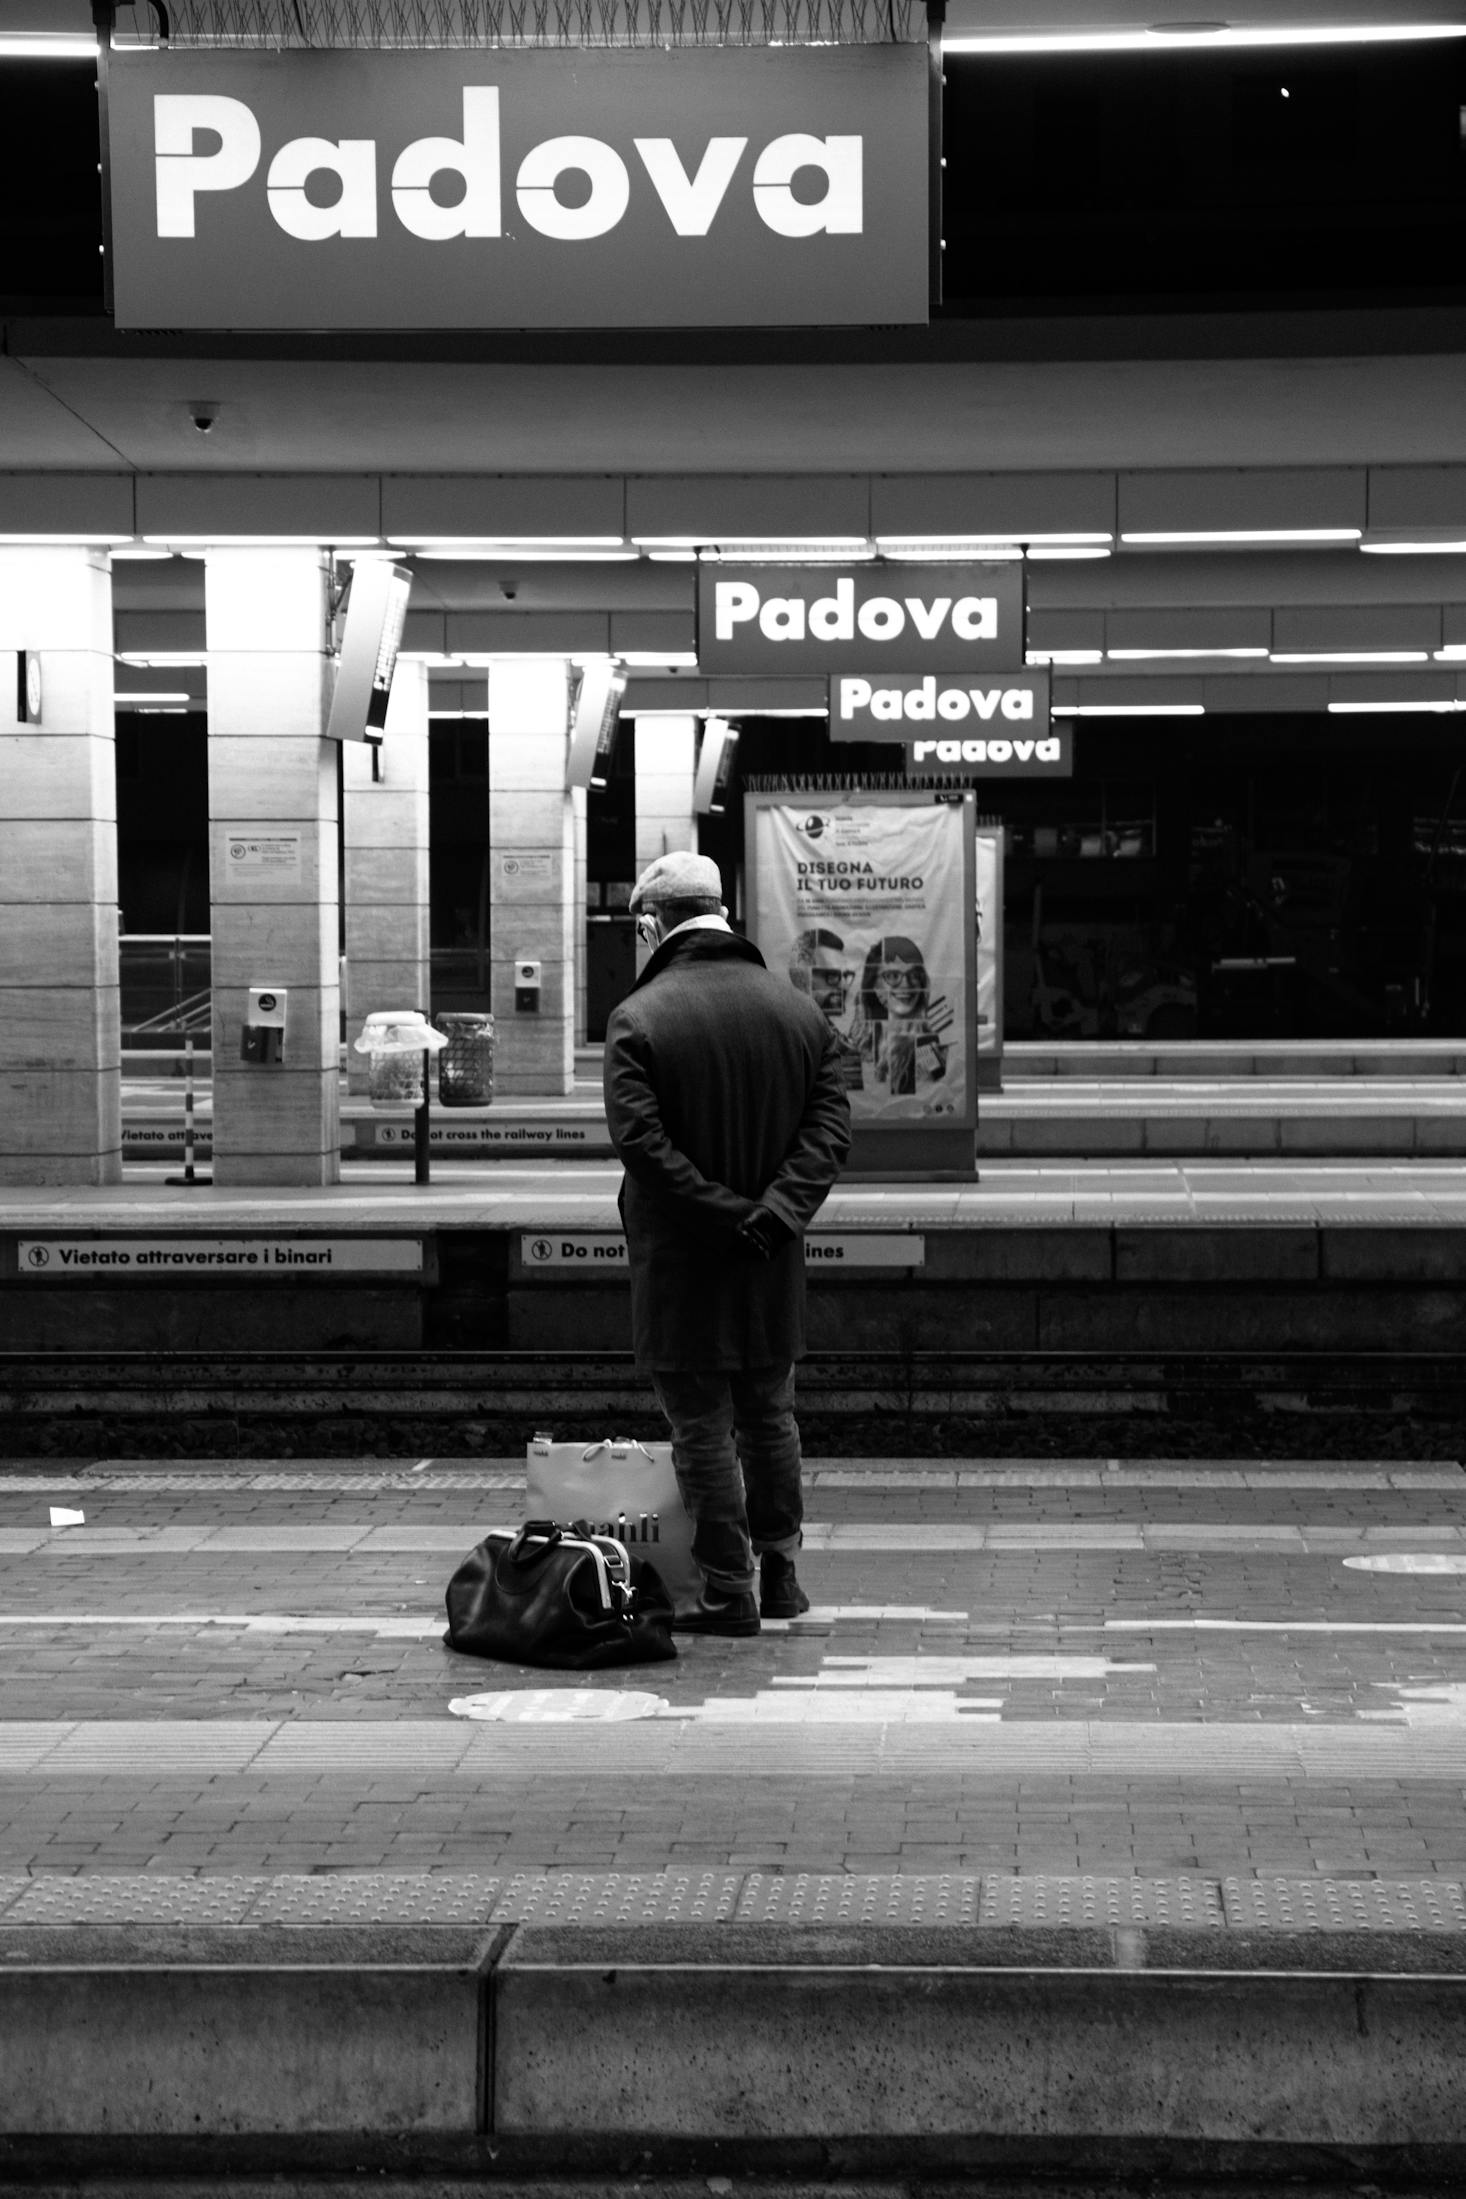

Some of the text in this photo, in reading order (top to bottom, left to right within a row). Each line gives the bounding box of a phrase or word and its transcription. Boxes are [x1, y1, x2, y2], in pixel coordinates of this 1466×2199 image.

[154, 86, 862, 240] Padova
[715, 578, 997, 641] Padova
[840, 676, 1034, 720] Padova
[797, 861, 873, 875] DISEGNA
[797, 876, 924, 891] IL TUO FUTURO
[446, 1130, 477, 1140] cross
[481, 1128, 501, 1140] the
[504, 1128, 552, 1142] railway
[556, 1128, 585, 1140] lines
[59, 1248, 332, 1265] Vietato attraversare i binari
[561, 1242, 844, 1259] Do not ines
